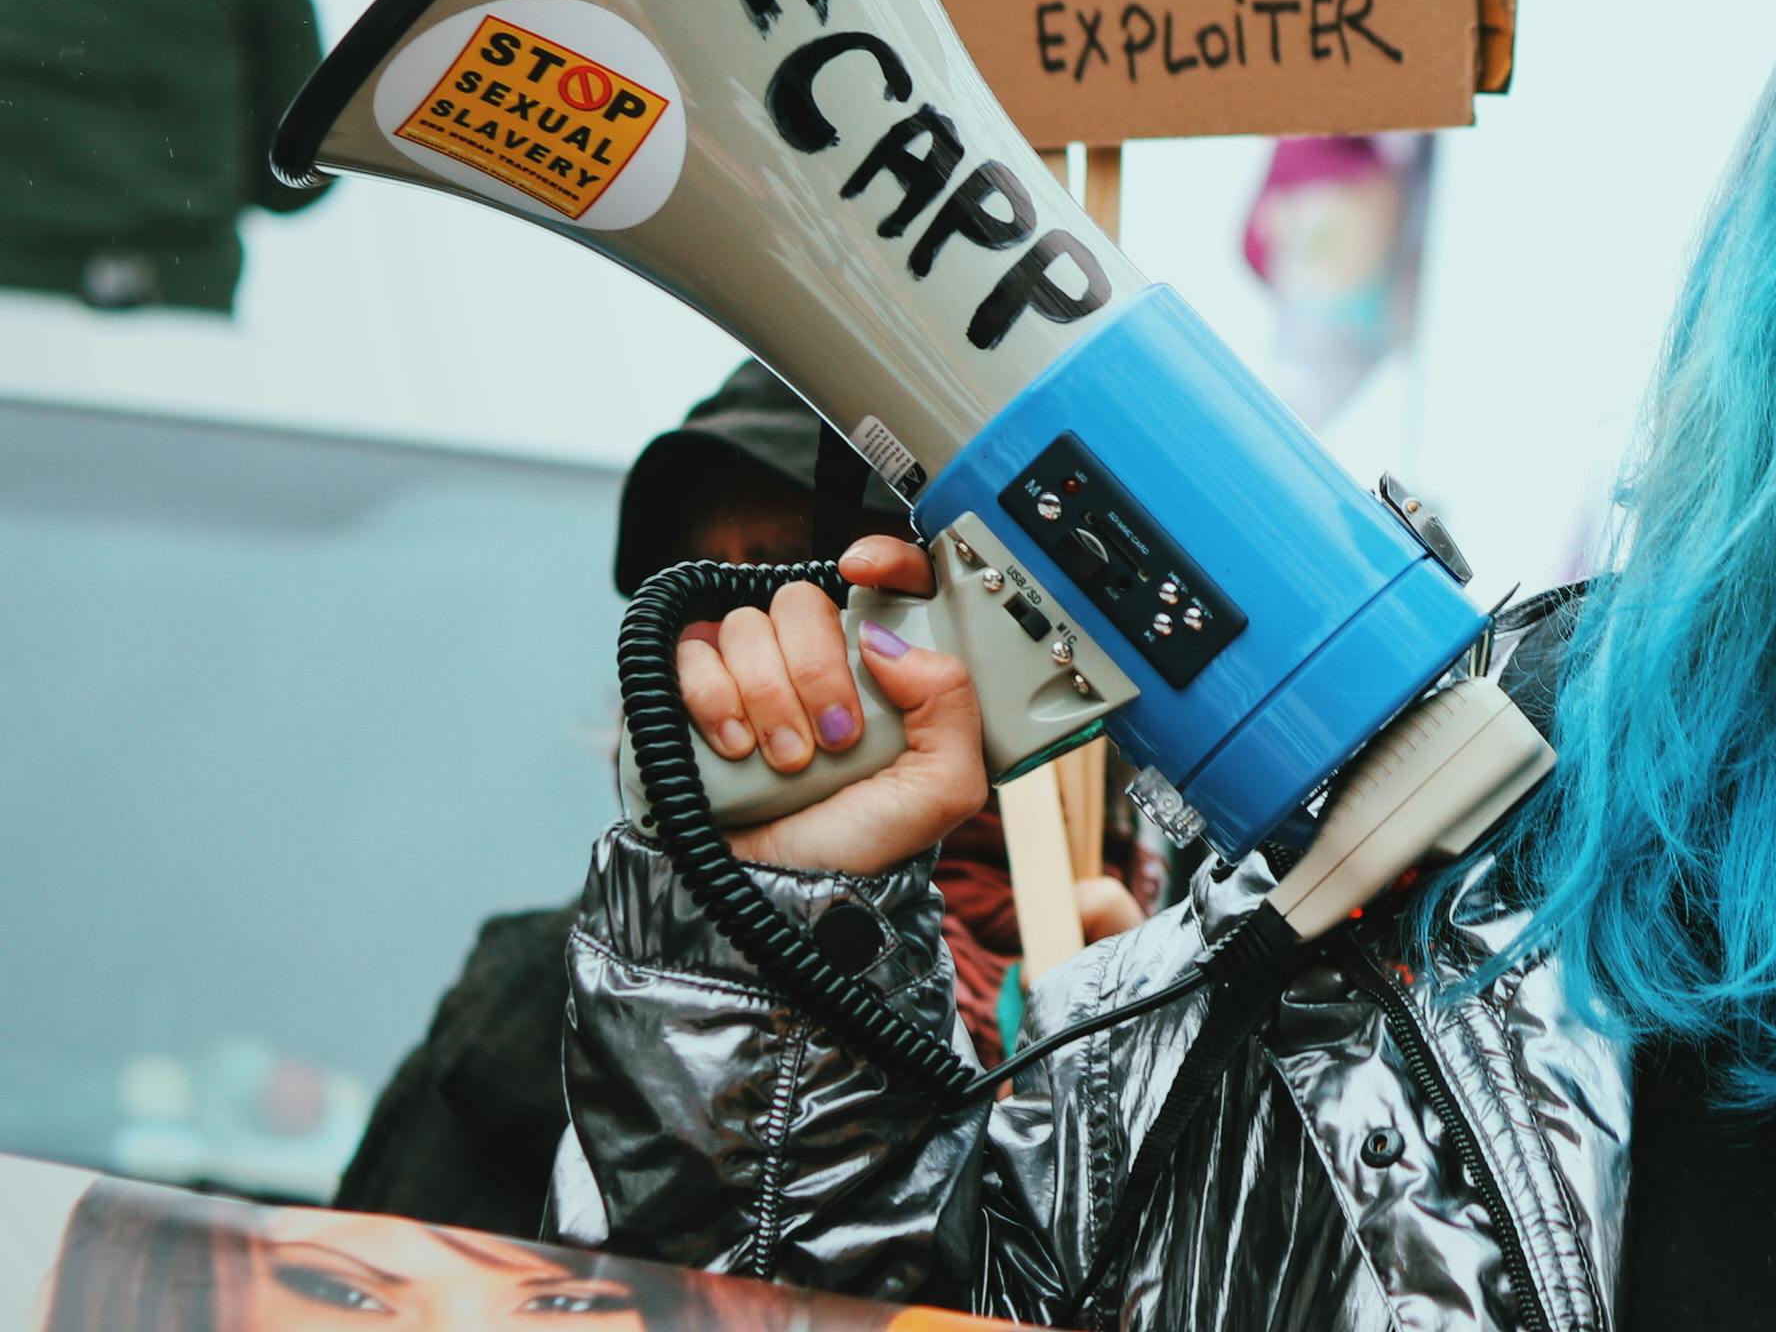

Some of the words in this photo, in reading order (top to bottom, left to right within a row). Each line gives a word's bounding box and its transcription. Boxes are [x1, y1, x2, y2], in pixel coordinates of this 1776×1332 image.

[454, 70, 613, 166] SEXUAL
[480, 32, 647, 123] STOP
[419, 119, 445, 133] END
[448, 131, 495, 155] HUMAN
[499, 154, 580, 202] TRAFFICKING
[430, 98, 601, 189] SLAVERY
[1006, 564, 1042, 606] USB/SD
[1055, 622, 1078, 645] MIC
